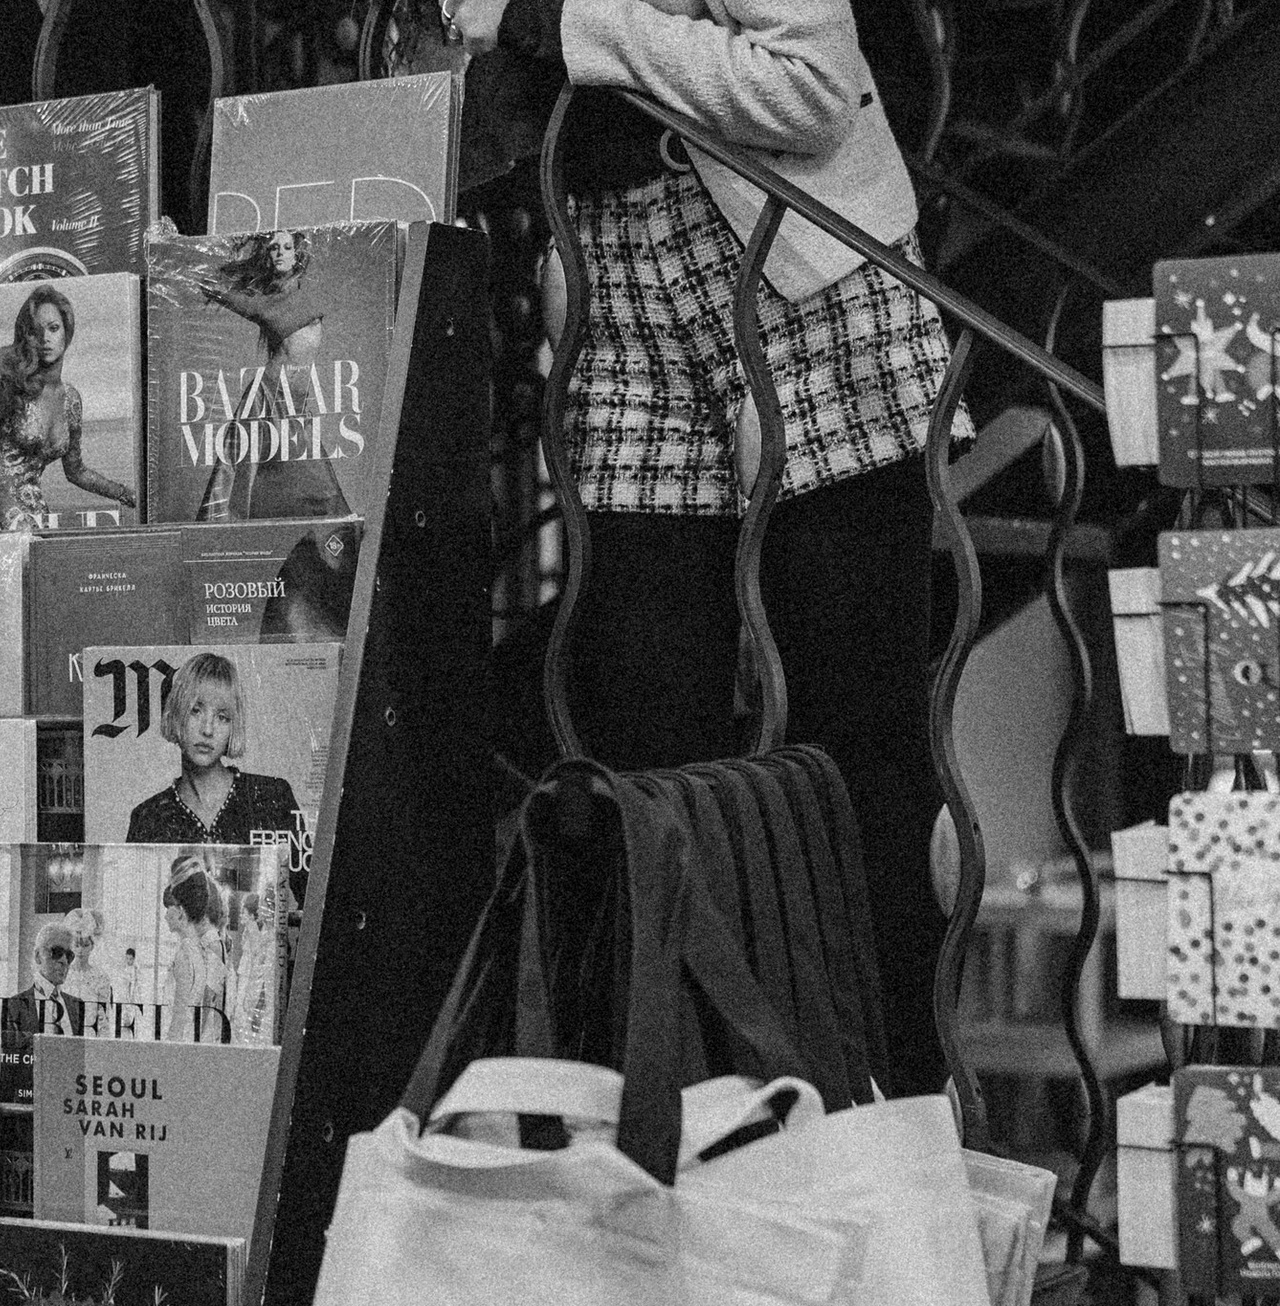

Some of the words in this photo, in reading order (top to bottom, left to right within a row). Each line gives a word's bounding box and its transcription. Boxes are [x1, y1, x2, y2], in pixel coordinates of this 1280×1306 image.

[51, 218, 87, 231] Volume
[179, 360, 363, 424] BAZAAR
[180, 414, 365, 467] MODELS
[88, 572, 127, 580] ФРАНЧЕСКА
[204, 577, 286, 599] РОЗОВЫЙ
[206, 603, 252, 614] ИСТОРИЯ
[207, 616, 238, 627] ЦВЕТА
[75, 1074, 163, 1101] SEOUL
[64, 1098, 135, 1119] SARAH
[79, 1118, 126, 1138] VAN
[136, 1123, 168, 1142] RIJ
